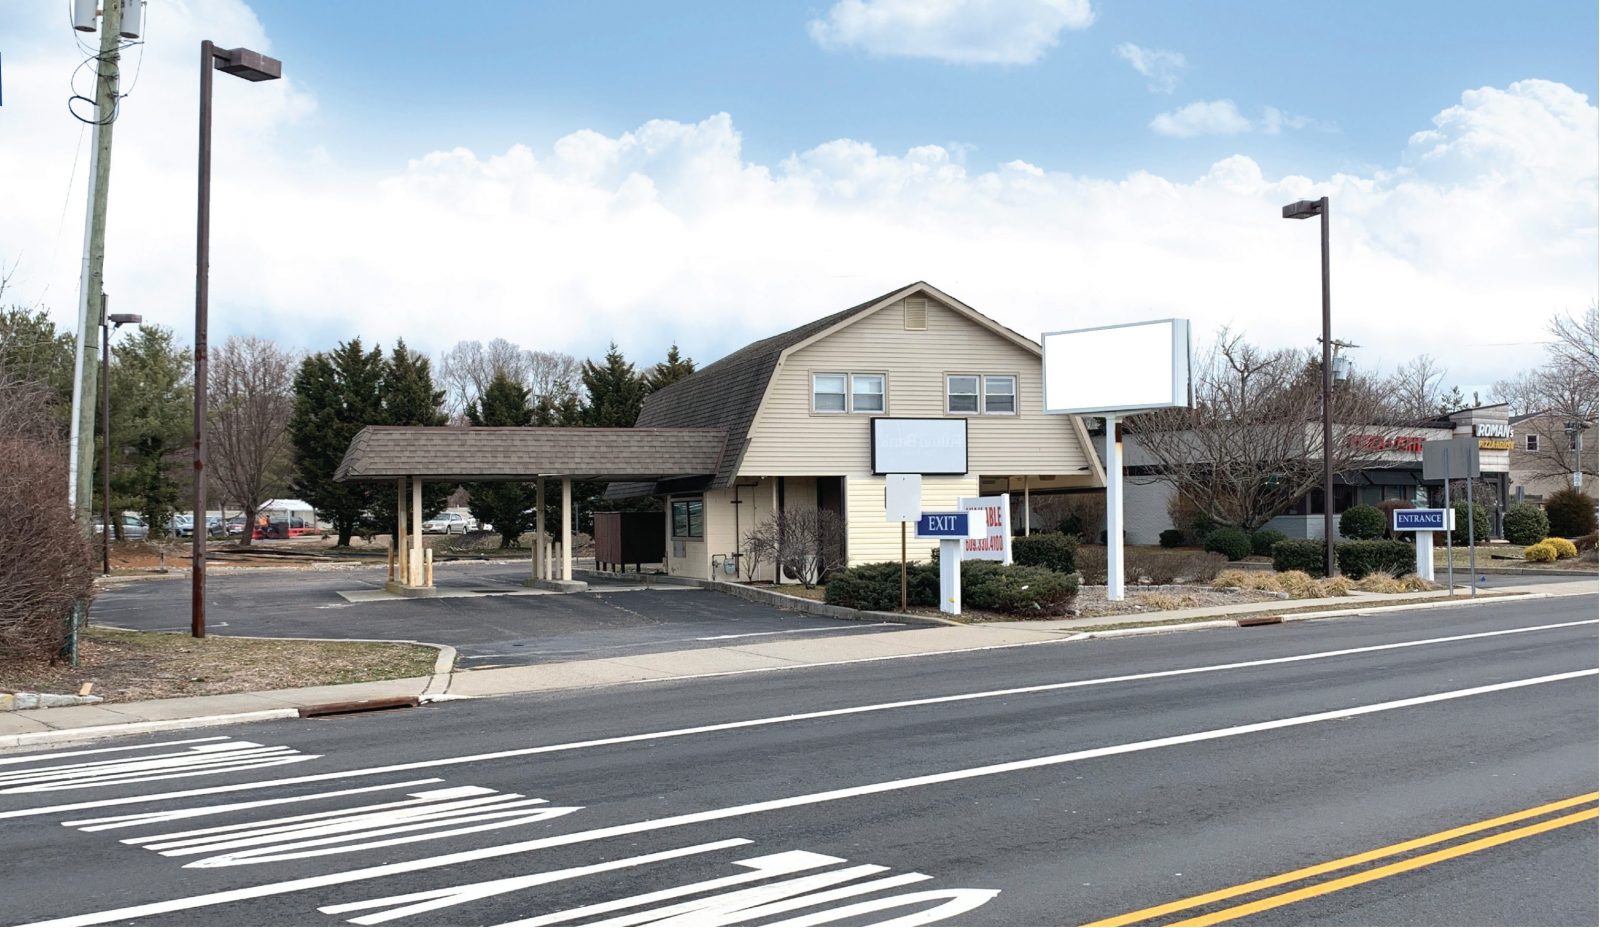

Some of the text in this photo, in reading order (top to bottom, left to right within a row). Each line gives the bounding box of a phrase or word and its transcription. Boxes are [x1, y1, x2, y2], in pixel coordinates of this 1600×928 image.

[928, 515, 957, 531] EXIT
[1398, 514, 1442, 523] ENTRANCE
[61, 777, 586, 869] ONLY
